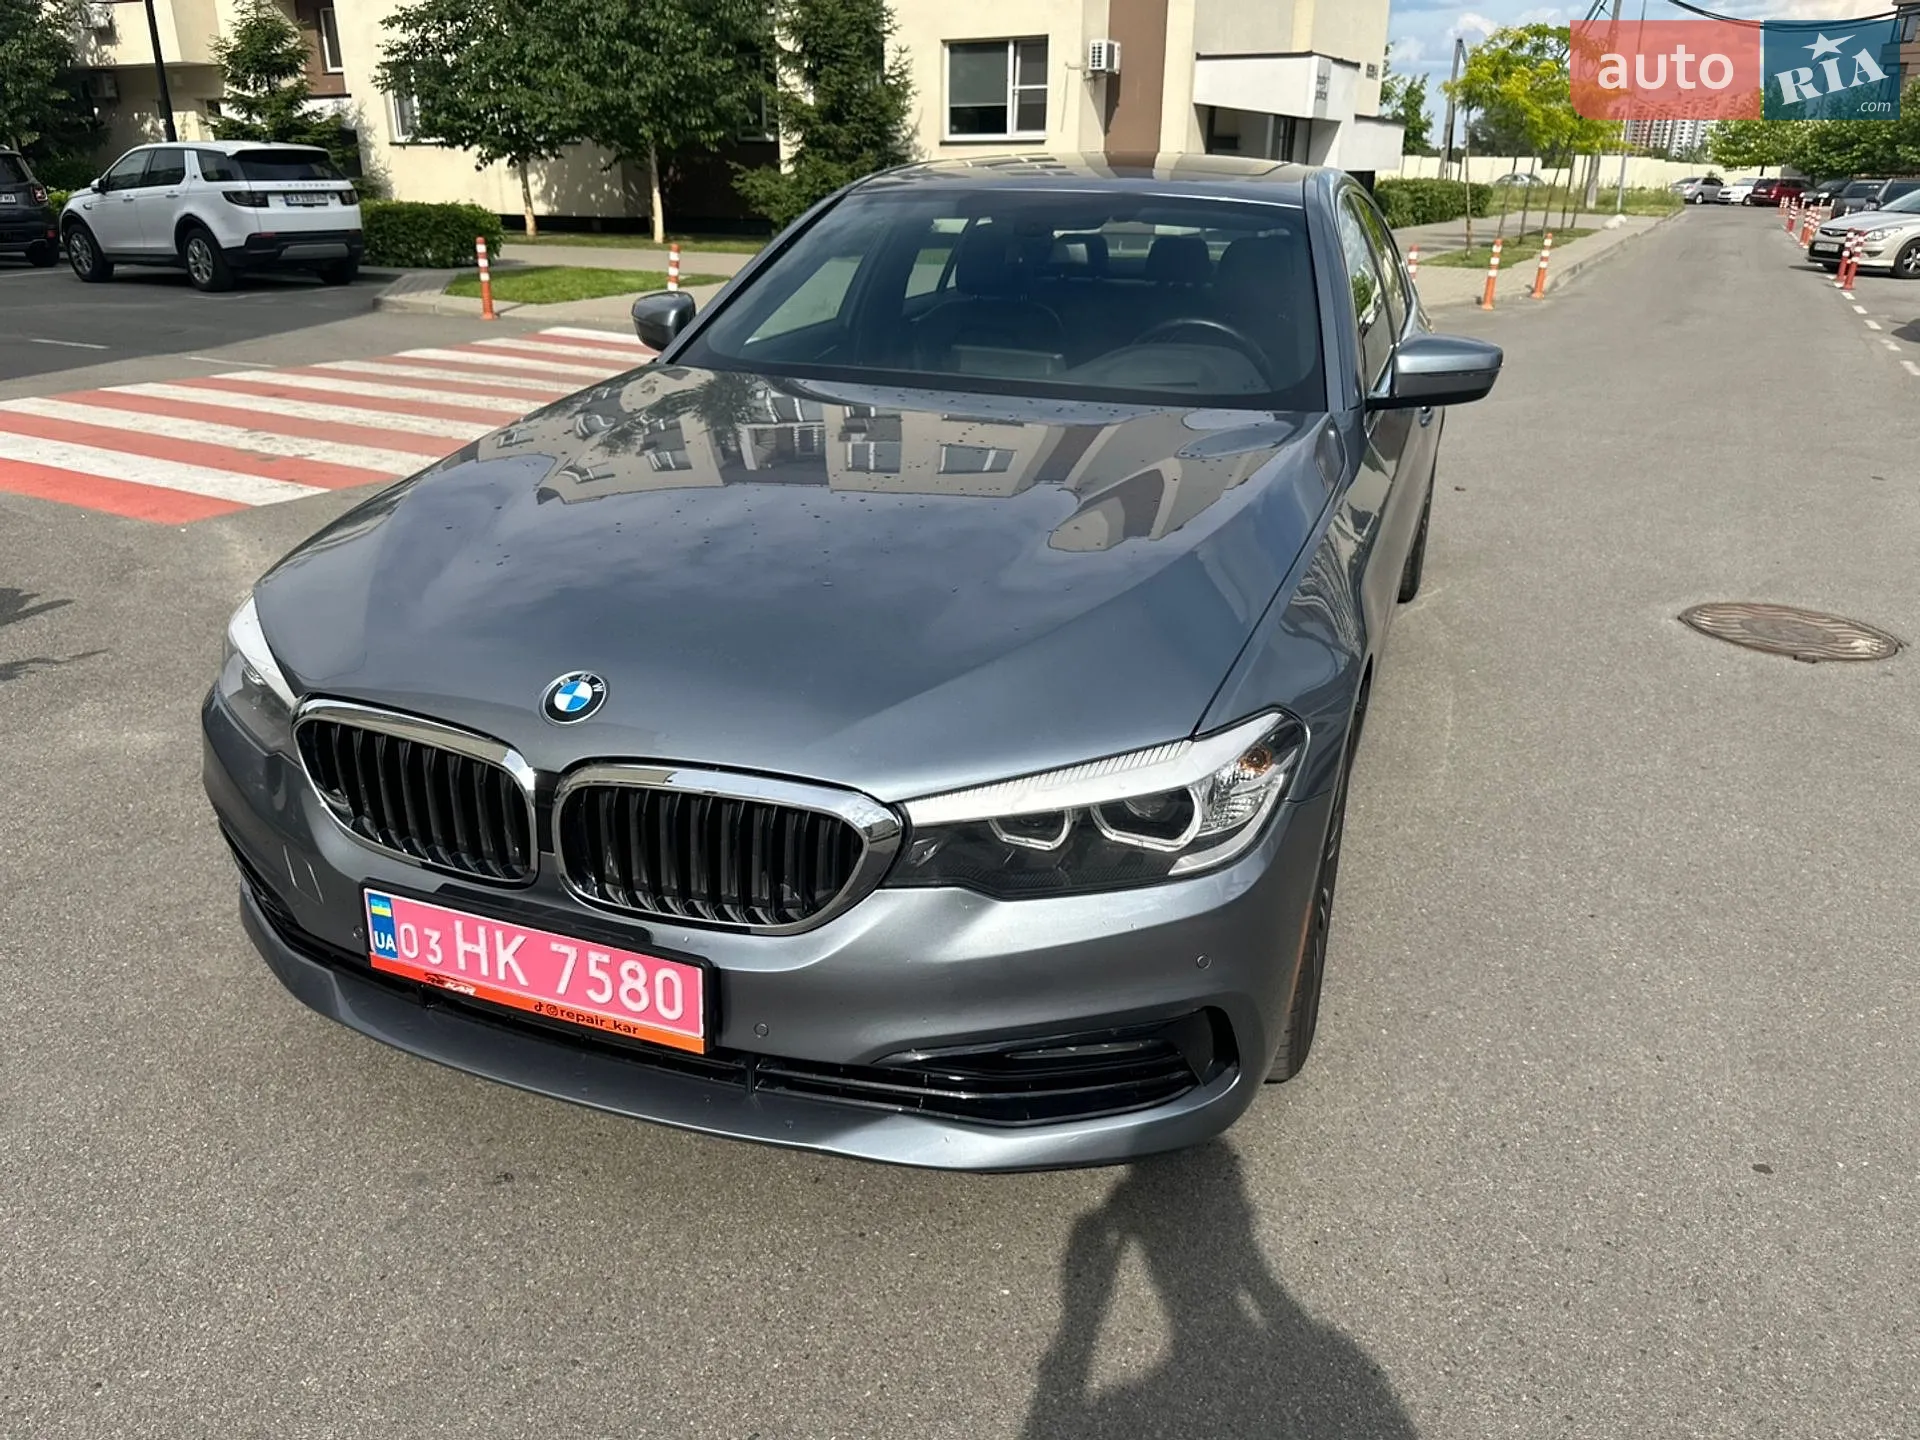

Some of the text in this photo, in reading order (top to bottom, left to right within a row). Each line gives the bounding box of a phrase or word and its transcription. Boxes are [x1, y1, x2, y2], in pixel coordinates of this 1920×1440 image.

[374, 931, 397, 952] UA
[400, 920, 684, 1021] 03 HK 7580
